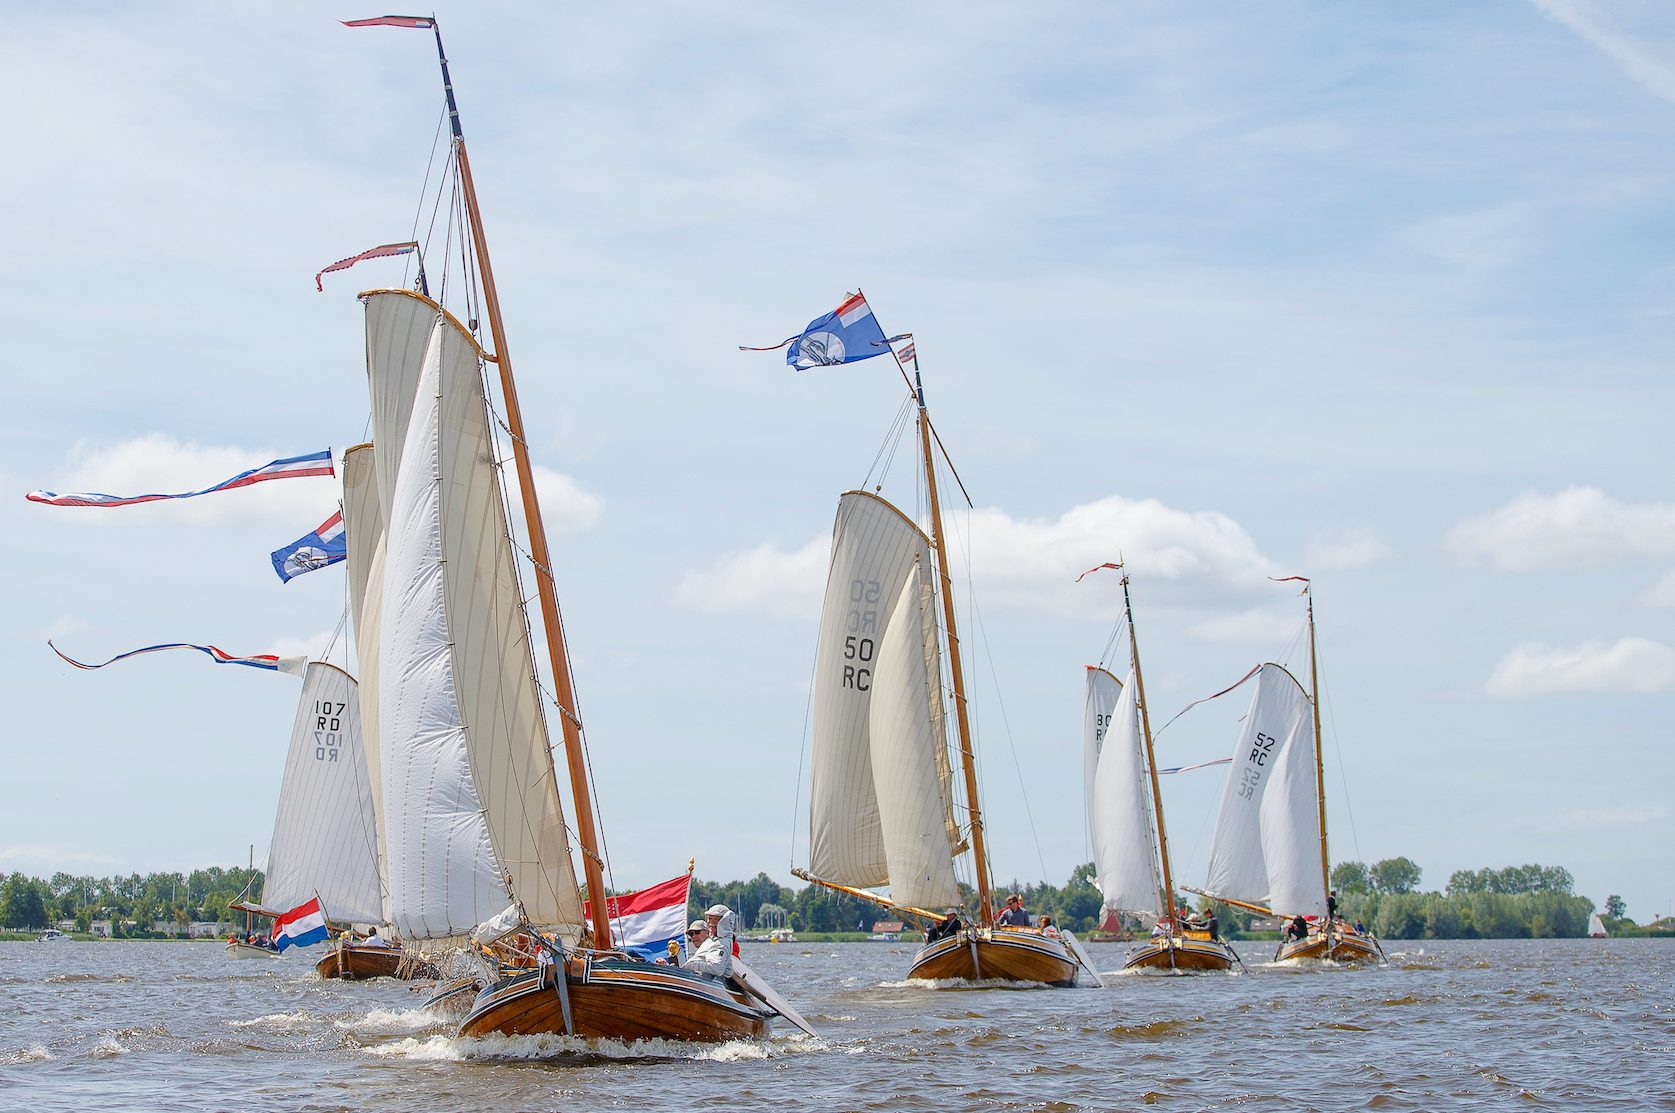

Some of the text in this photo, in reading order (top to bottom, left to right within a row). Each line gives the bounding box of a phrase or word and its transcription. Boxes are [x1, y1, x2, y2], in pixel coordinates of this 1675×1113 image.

[844, 635, 874, 662] 50
[842, 665, 871, 692] RC
[315, 700, 346, 716] 107
[317, 716, 340, 731] RD
[1096, 729, 1107, 741] R
[1254, 732, 1275, 752] 52
[1249, 748, 1268, 767] RC
